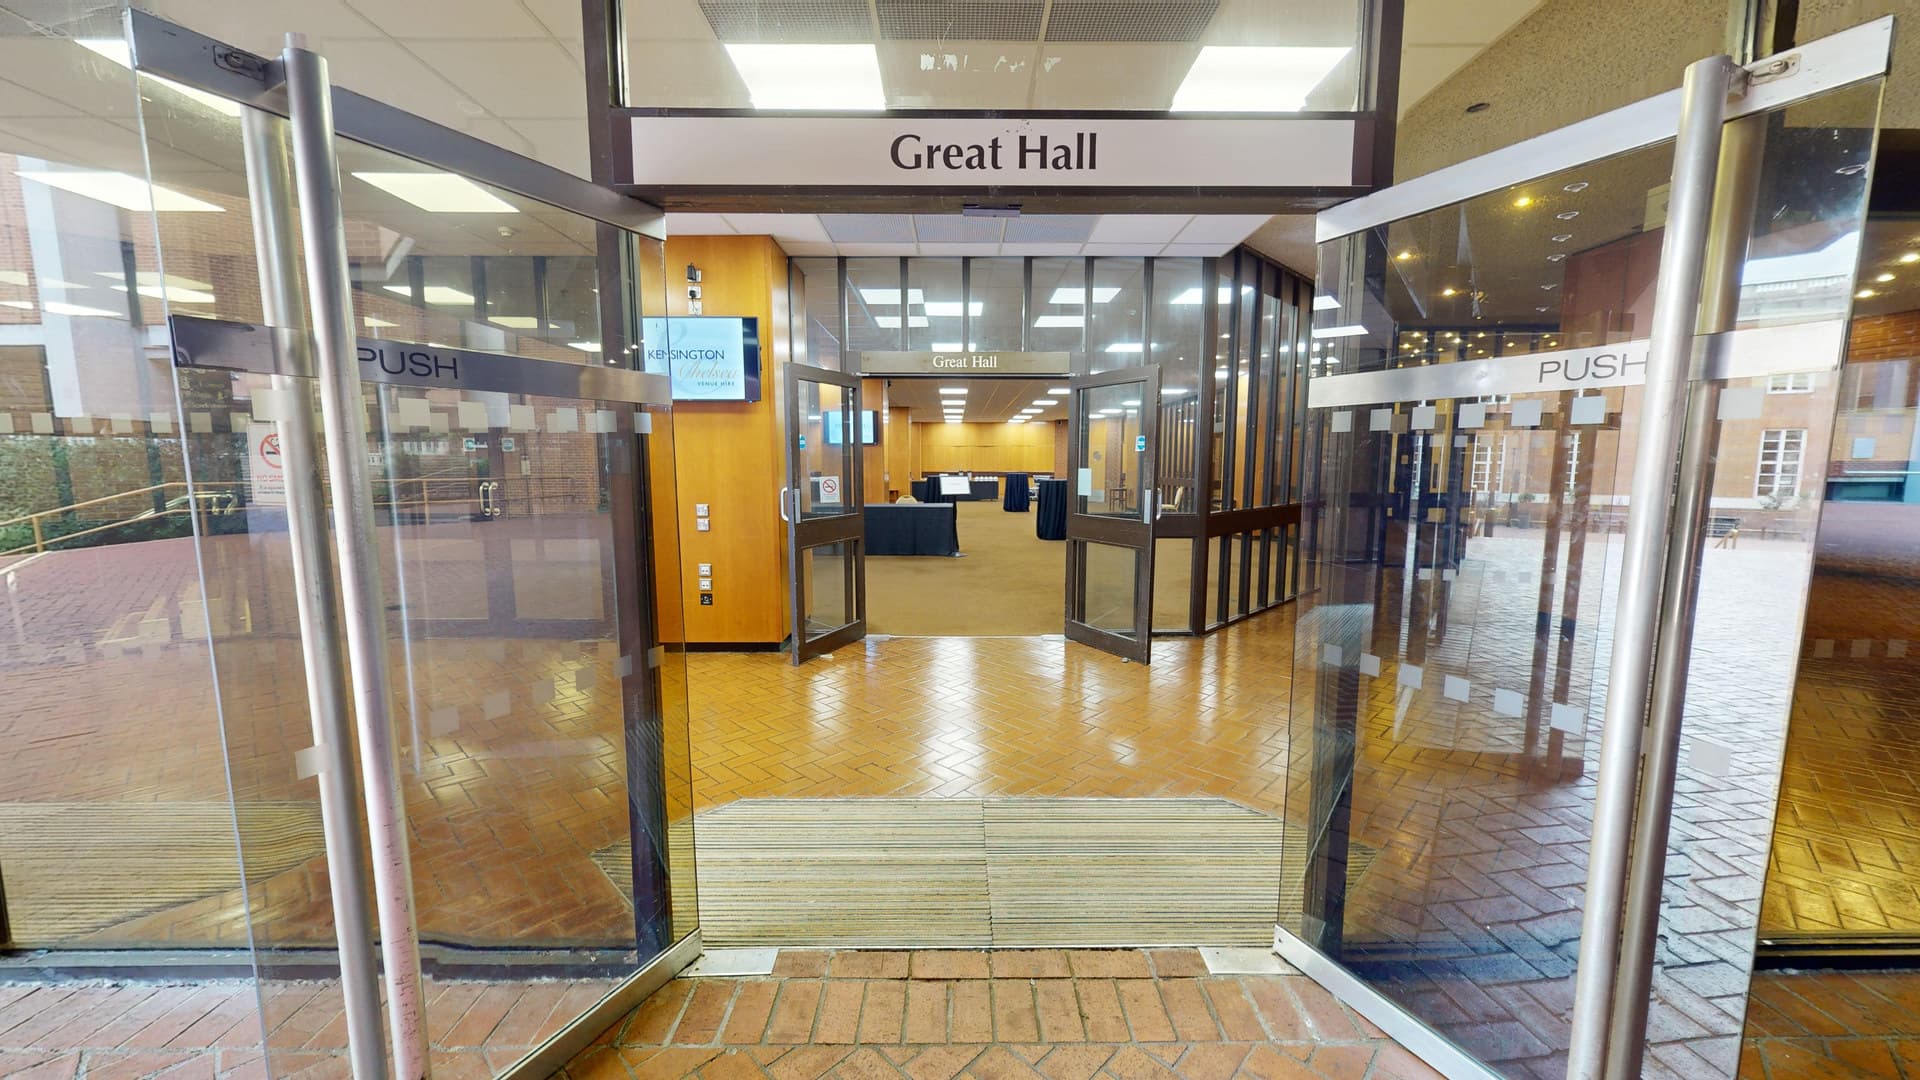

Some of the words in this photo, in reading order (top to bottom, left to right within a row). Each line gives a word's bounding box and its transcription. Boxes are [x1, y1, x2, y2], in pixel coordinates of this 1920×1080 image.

[890, 134, 1003, 170] Great
[1018, 132, 1097, 170] Hall
[357, 347, 458, 379] PUSH
[647, 349, 725, 360] KENSINGTON
[932, 355, 968, 368] Great
[972, 355, 998, 368] Hall
[1538, 352, 1648, 383] PUSH
